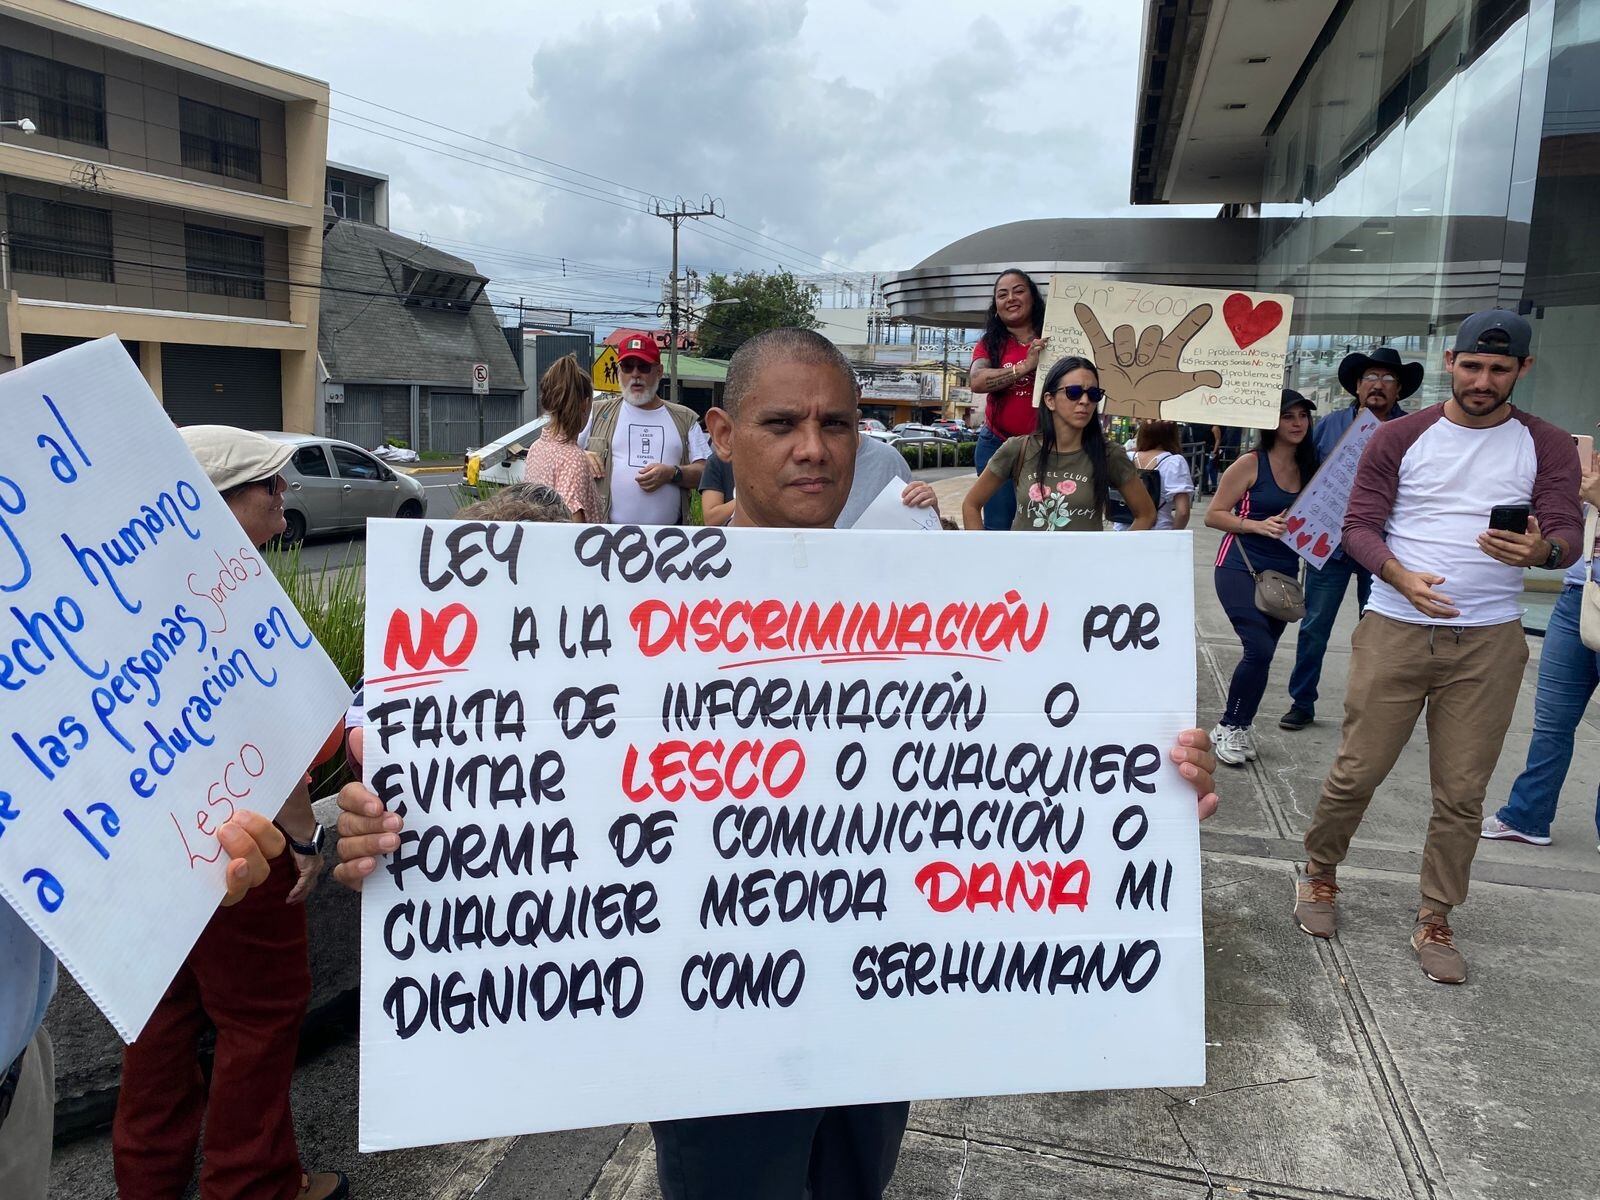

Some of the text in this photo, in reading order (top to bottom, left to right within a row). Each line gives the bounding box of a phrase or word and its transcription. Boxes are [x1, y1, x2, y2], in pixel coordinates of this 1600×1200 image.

[1052, 276, 1089, 304] Ley
[1124, 287, 1188, 317] 7600
[1045, 343, 1087, 356] ersona
[1058, 337, 1079, 345] una
[1270, 352, 1286, 361] que
[1234, 387, 1267, 396] oyente
[1241, 380, 1250, 388] el
[1252, 381, 1284, 391] mundo
[37, 394, 92, 484] al
[1063, 472, 1088, 482] CLUB
[60, 480, 202, 615] humano
[419, 522, 733, 592] LEY 9822
[11, 714, 90, 782] las
[91, 603, 208, 754] personas
[187, 547, 262, 634] Sordas
[383, 589, 1161, 672] NO A LA DISCRIMINACIÓN POR
[62, 801, 122, 861] la
[129, 646, 278, 799] educación
[253, 605, 313, 650] en
[366, 671, 1080, 755] FALTA DE INFORMACIÓN O
[371, 738, 1161, 819] EVITAR LESCO O CUALQUIER
[386, 797, 1149, 892] FORMA DE COMUNICACIÓN O
[383, 859, 1173, 961] CUALQUIER MEDIDA DAÑA MI
[382, 956, 644, 1040] DIGNIDAD
[680, 949, 806, 1011] COMO
